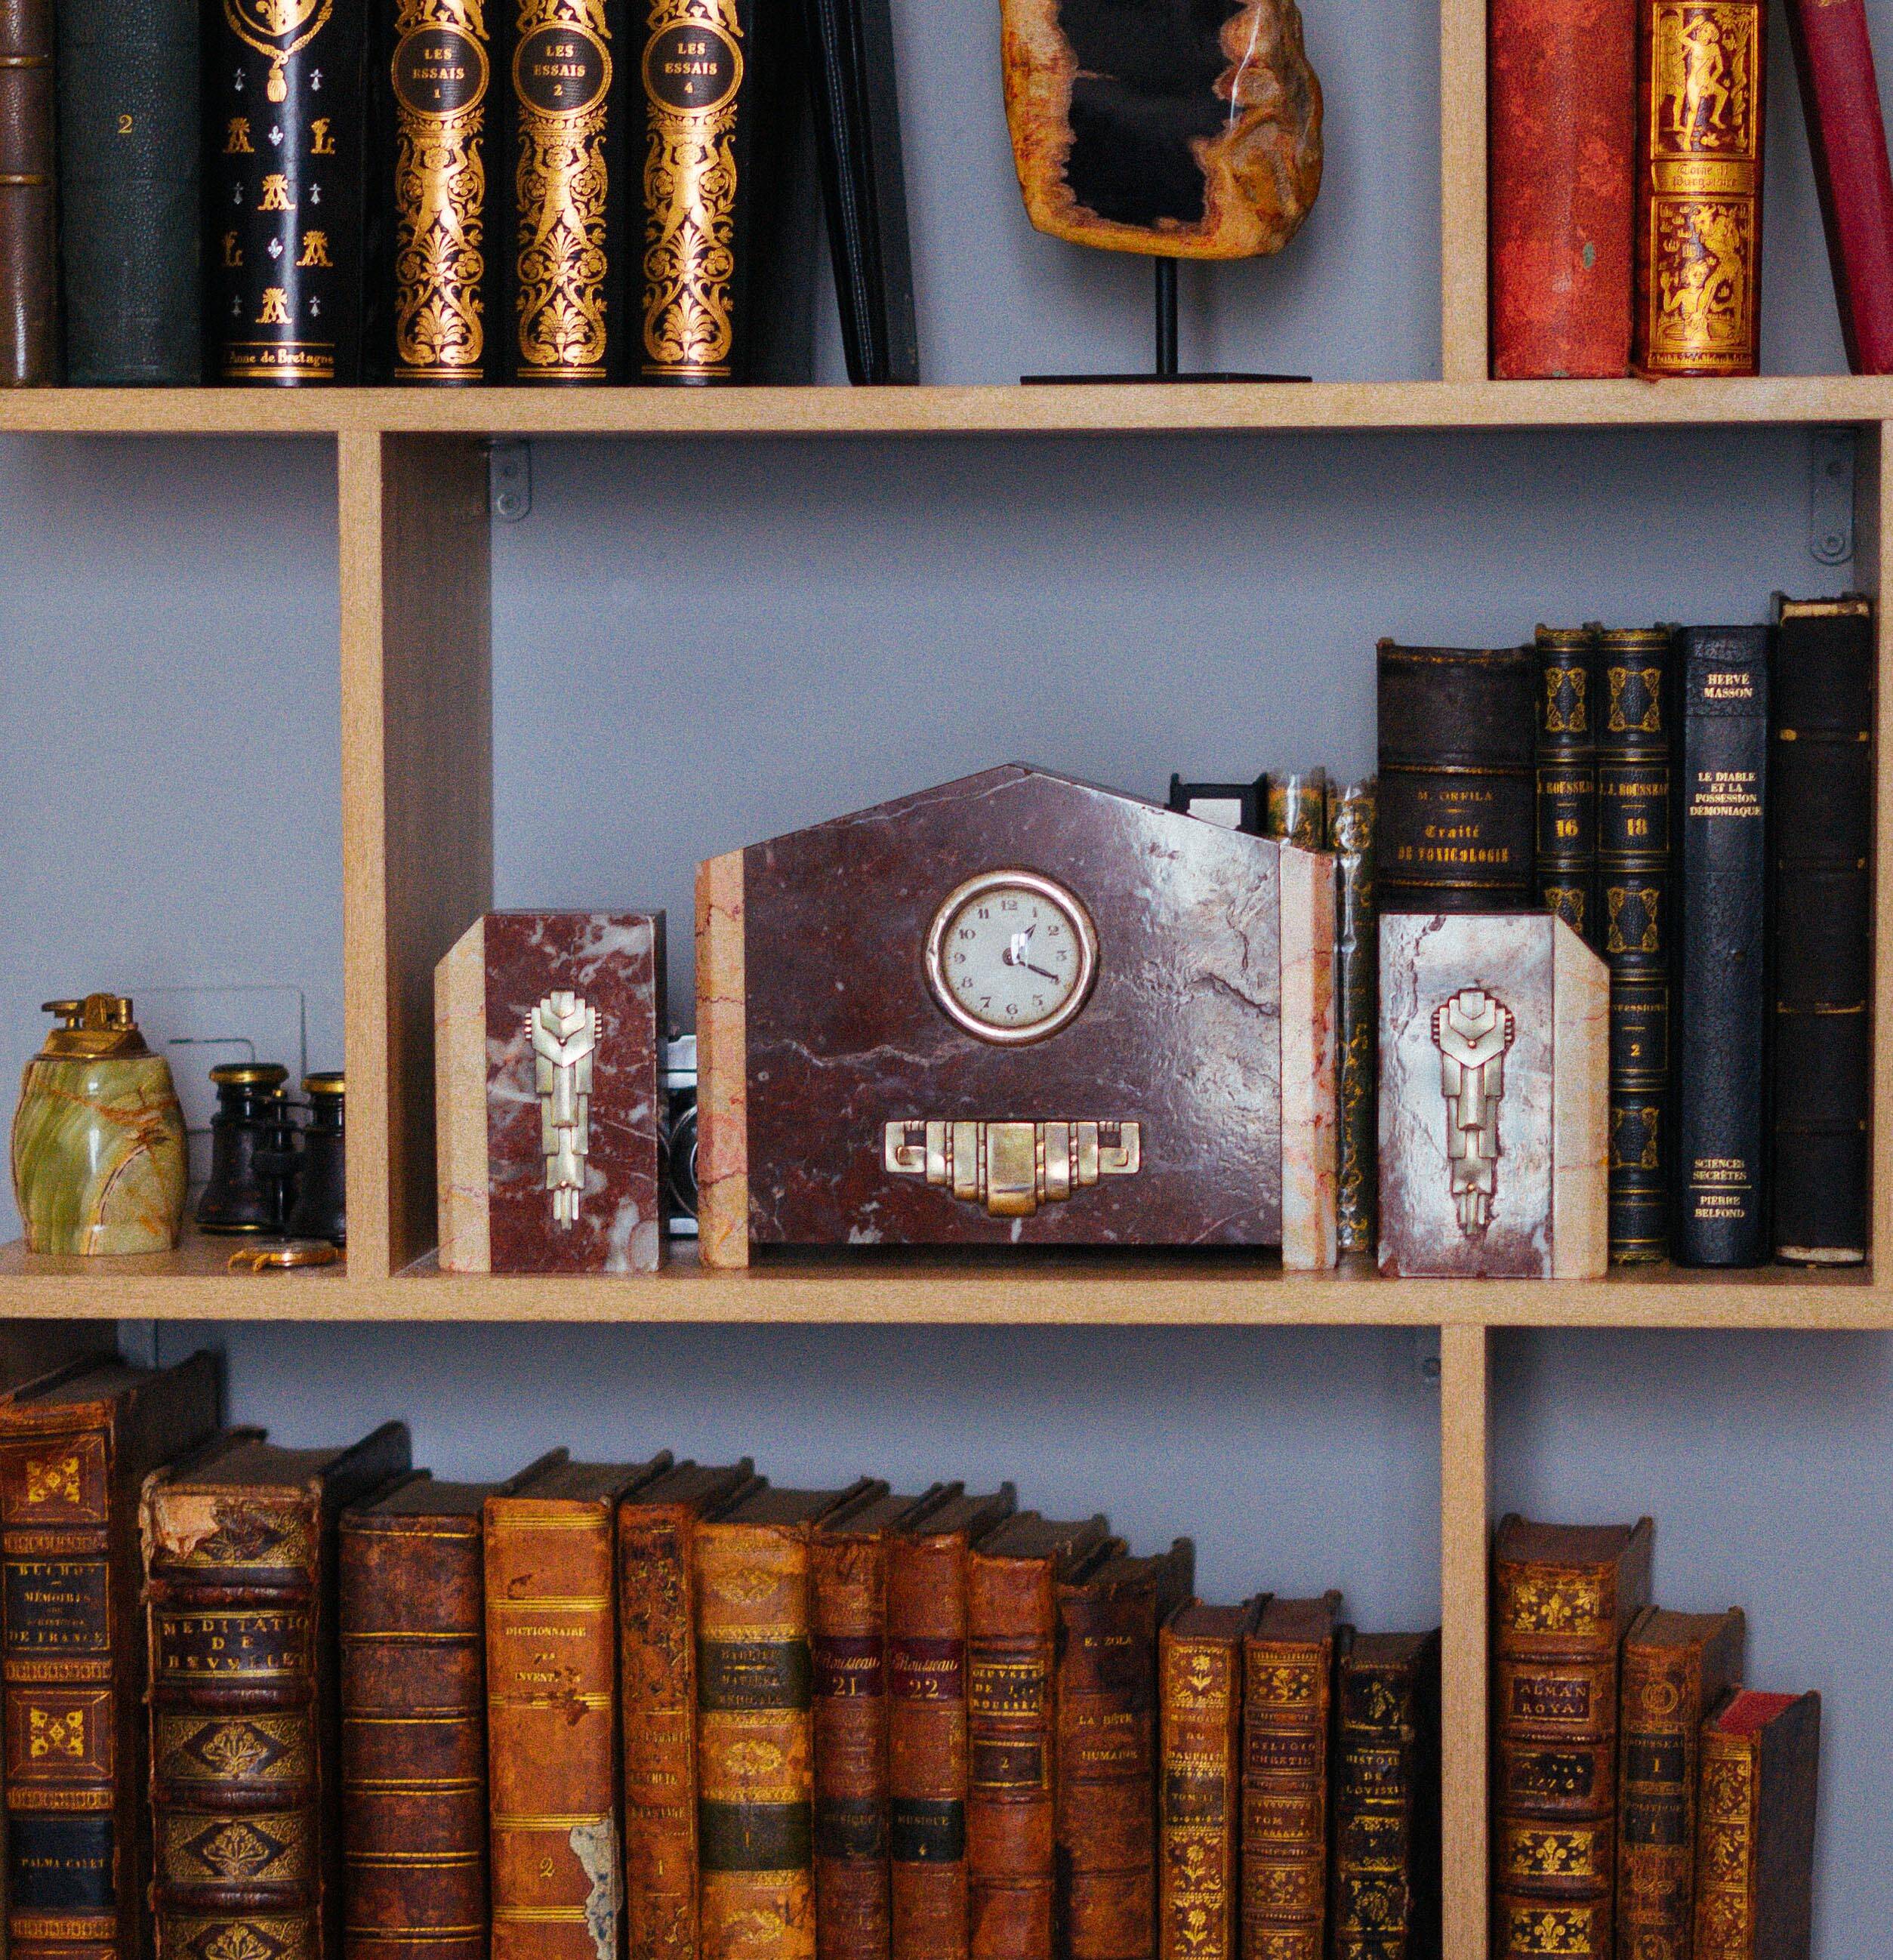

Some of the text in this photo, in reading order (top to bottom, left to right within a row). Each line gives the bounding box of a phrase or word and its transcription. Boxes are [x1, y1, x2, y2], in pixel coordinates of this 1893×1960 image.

[424, 48, 452, 60] LES
[546, 45, 574, 57] LES
[678, 42, 705, 55] LES
[412, 67, 464, 79] ESSAIS
[533, 65, 586, 77] ESSAIS
[664, 62, 717, 75] ESSAIS
[434, 88, 441, 99] 1
[553, 85, 563, 96] 2
[684, 82, 694, 94] 4
[118, 115, 133, 134] 2
[261, 350, 276, 363] de
[277, 348, 334, 368] Bretagne
[1706, 672, 1750, 686] HERVÉ
[1703, 687, 1753, 698] MASSON
[1698, 772, 1756, 782] LE DIABLE
[1710, 783, 1743, 793] ET LA
[1439, 790, 1493, 802] ORFILA
[1694, 793, 1757, 804] POSSESSION
[1689, 804, 1763, 818] DÉMONIAQUE
[1555, 818, 1579, 837] 16
[1626, 818, 1648, 837] 18
[1000, 900, 1017, 911] 12
[978, 908, 990, 920] 11
[1032, 907, 1037, 918] 1
[958, 929, 976, 940] 10
[954, 952, 966, 963] 9
[1056, 950, 1067, 962] 3
[961, 976, 973, 988] 8
[980, 996, 991, 1009] 7
[1006, 1003, 1018, 1015] 6
[1630, 1043, 1641, 1057] 2
[1694, 1158, 1745, 1169] SCIENCES
[1700, 1195, 1740, 1206] PIERRE
[1694, 1208, 1746, 1219] BELFOND
[505, 1626, 586, 1637] DICTIONNAIRE
[833, 1675, 859, 1697] 21
[908, 1678, 939, 1699] 22
[1078, 1715, 1094, 1725] LA
[540, 1858, 554, 1878] 2
